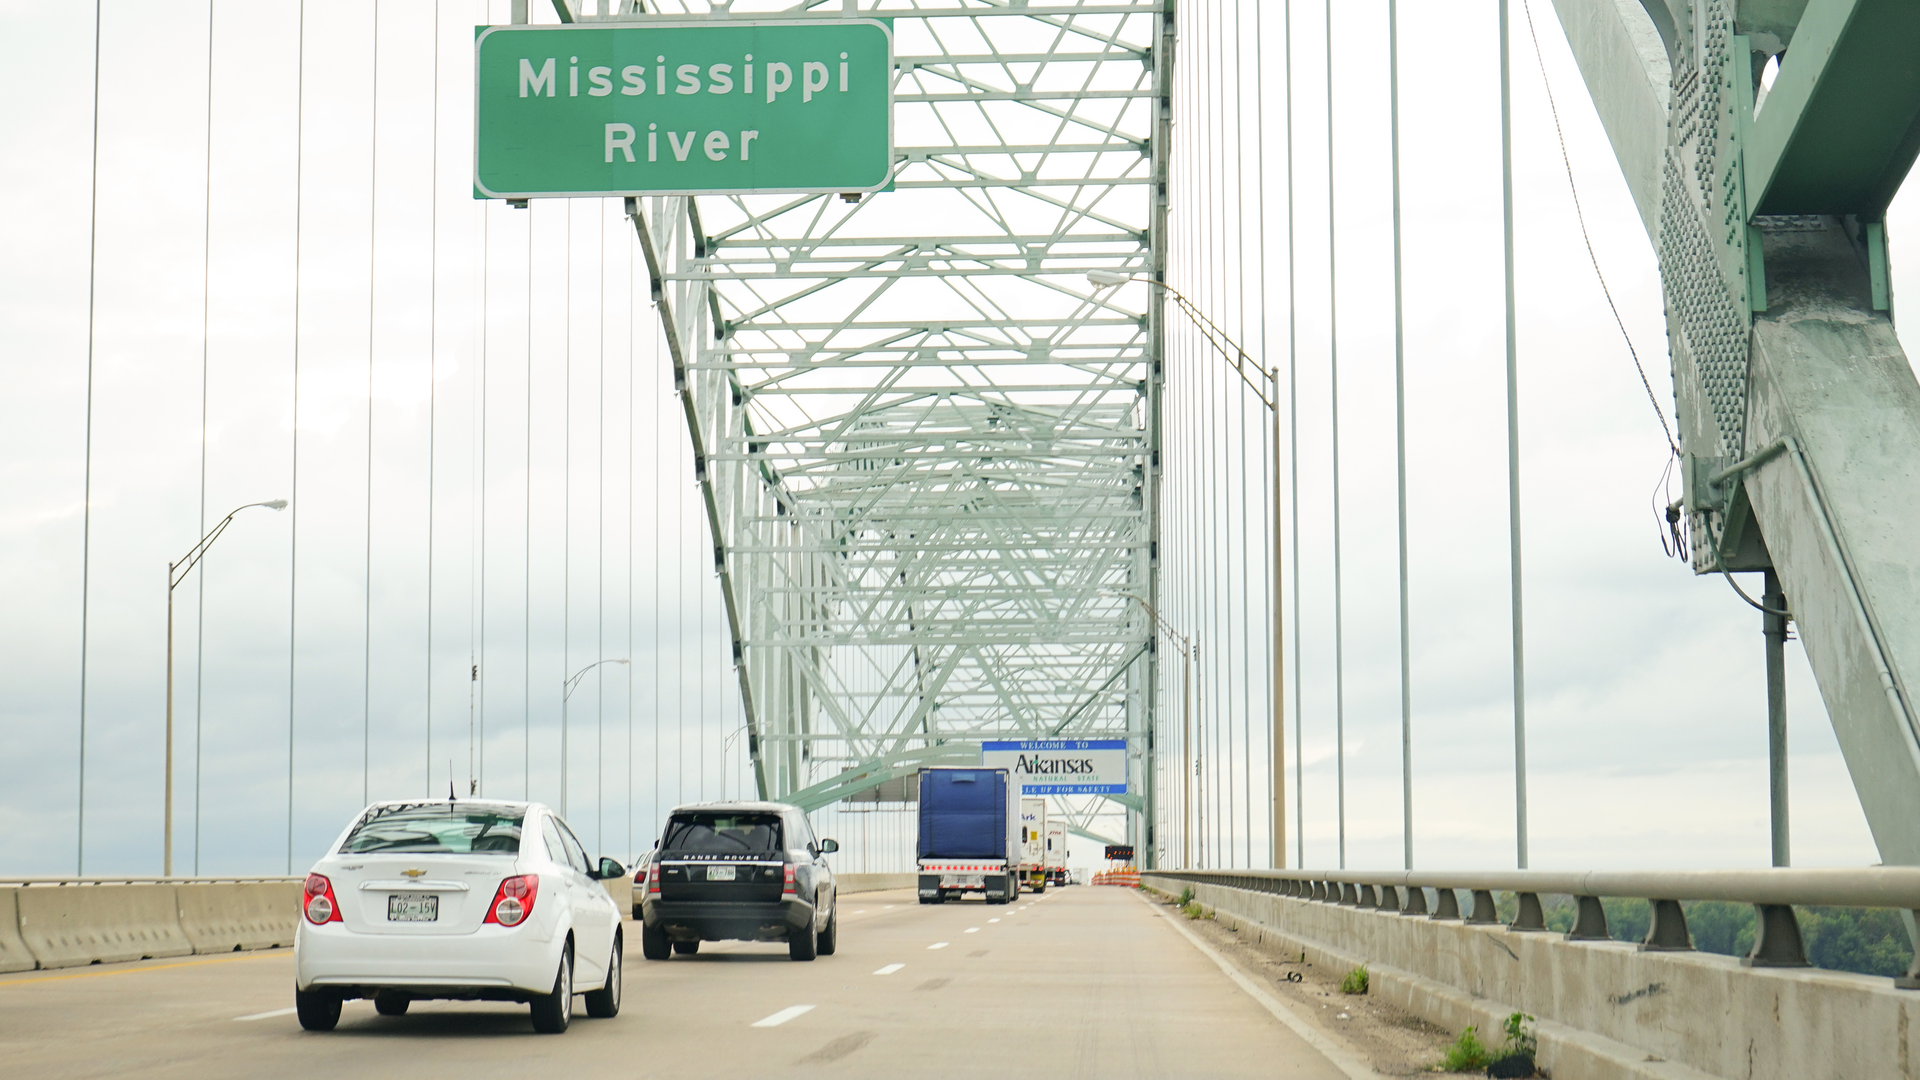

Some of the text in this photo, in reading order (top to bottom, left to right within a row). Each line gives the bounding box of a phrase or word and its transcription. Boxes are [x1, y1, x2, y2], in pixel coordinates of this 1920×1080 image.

[519, 52, 849, 104] Mississippi
[604, 122, 759, 163] River
[1020, 741, 1089, 750] WELCOME TO
[1015, 754, 1094, 774] Arkansas
[1056, 785, 1074, 793] FOR
[1077, 784, 1111, 793] SAFETY
